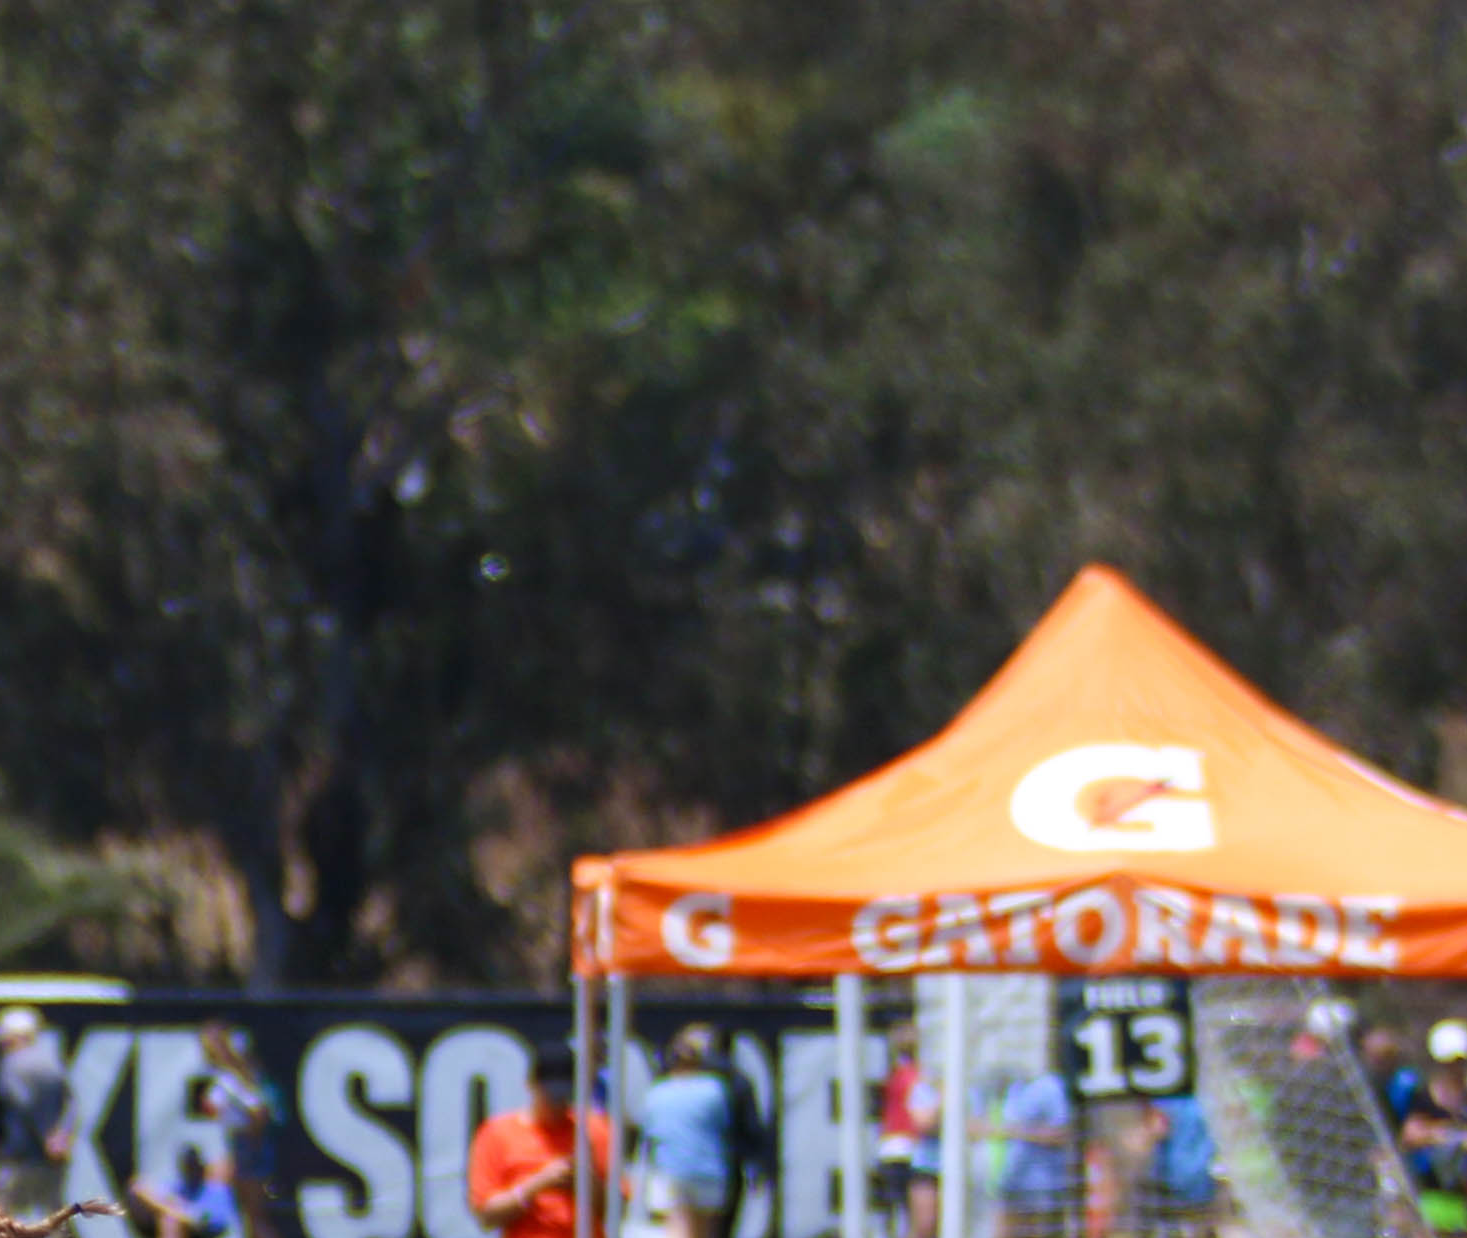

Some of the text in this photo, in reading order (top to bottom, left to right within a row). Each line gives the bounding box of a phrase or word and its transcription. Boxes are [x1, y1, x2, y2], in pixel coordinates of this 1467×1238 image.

[1009, 742, 1216, 852] G
[661, 891, 737, 969] G
[851, 885, 1402, 972] GATORADE
[1074, 1014, 1184, 1094] 13
